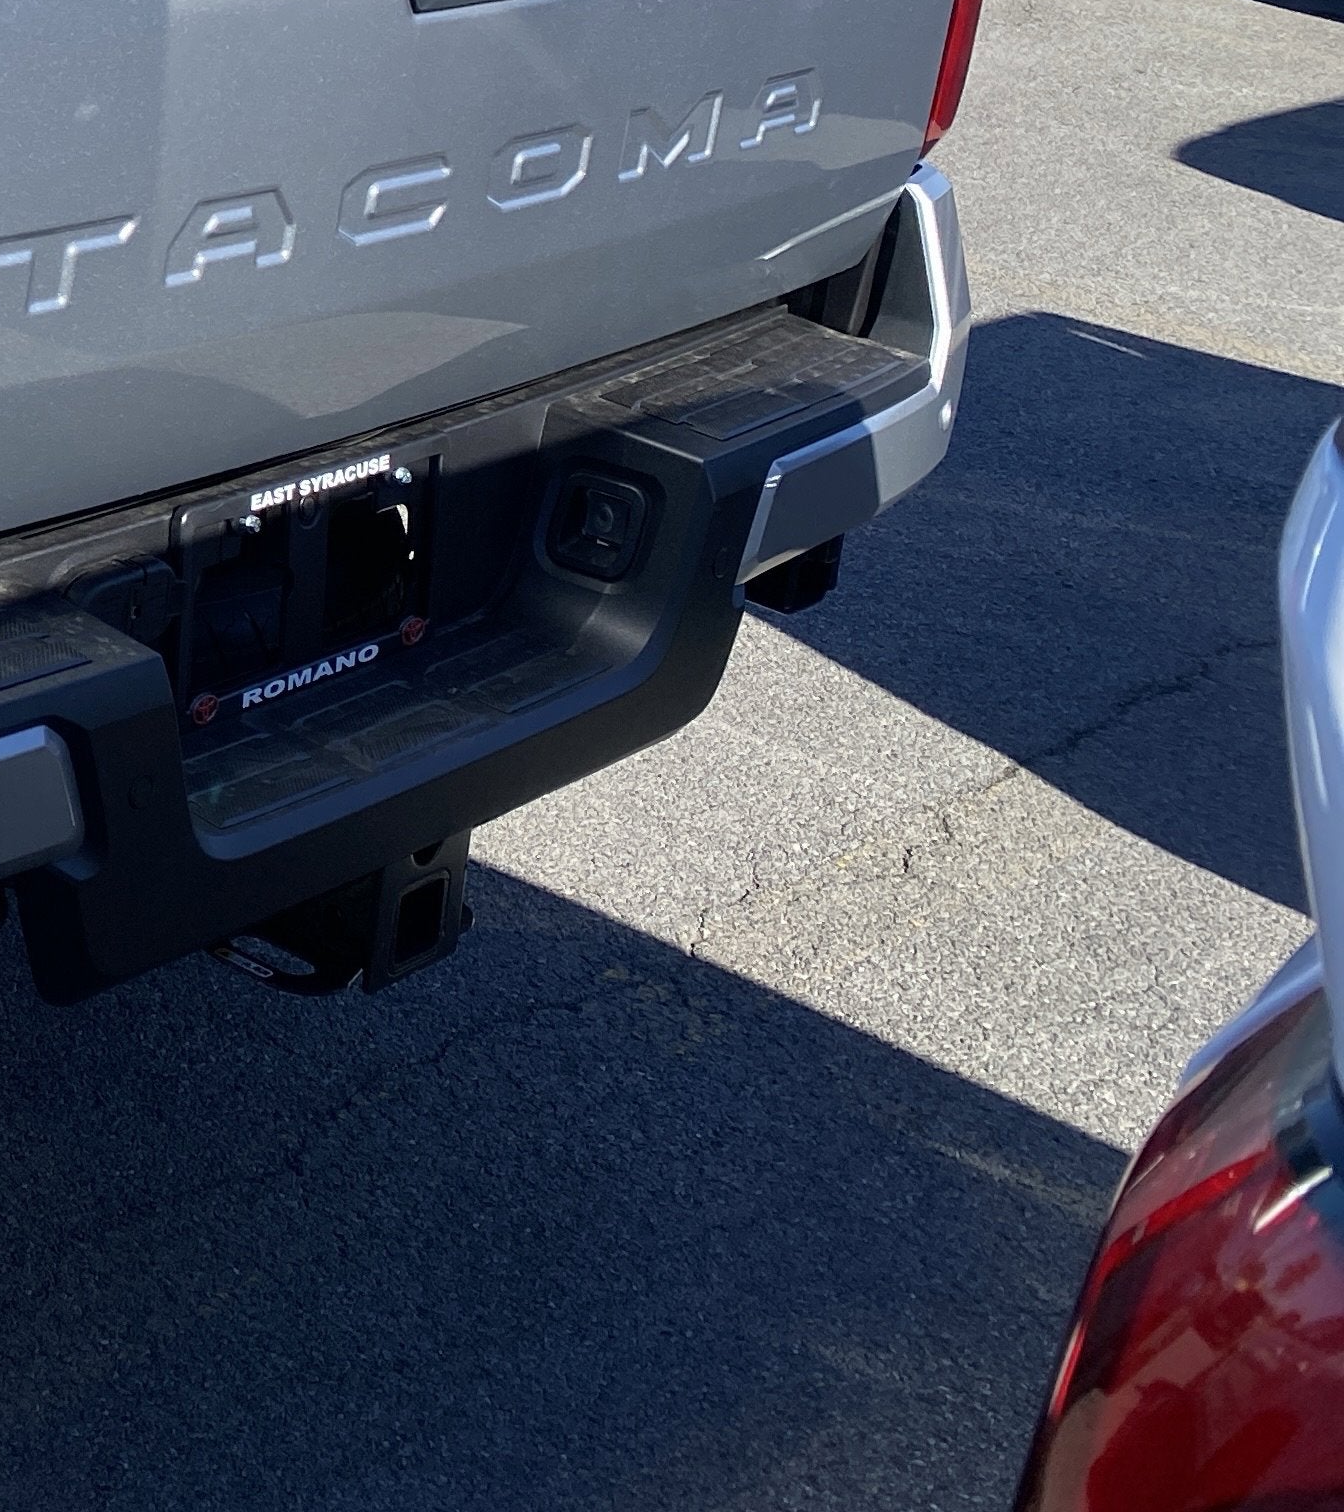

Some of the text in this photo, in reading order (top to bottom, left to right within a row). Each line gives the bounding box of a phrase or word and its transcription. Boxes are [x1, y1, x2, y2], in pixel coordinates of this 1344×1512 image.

[250, 454, 391, 511] EAST SYRACUSE
[241, 644, 380, 708] ROMANO
